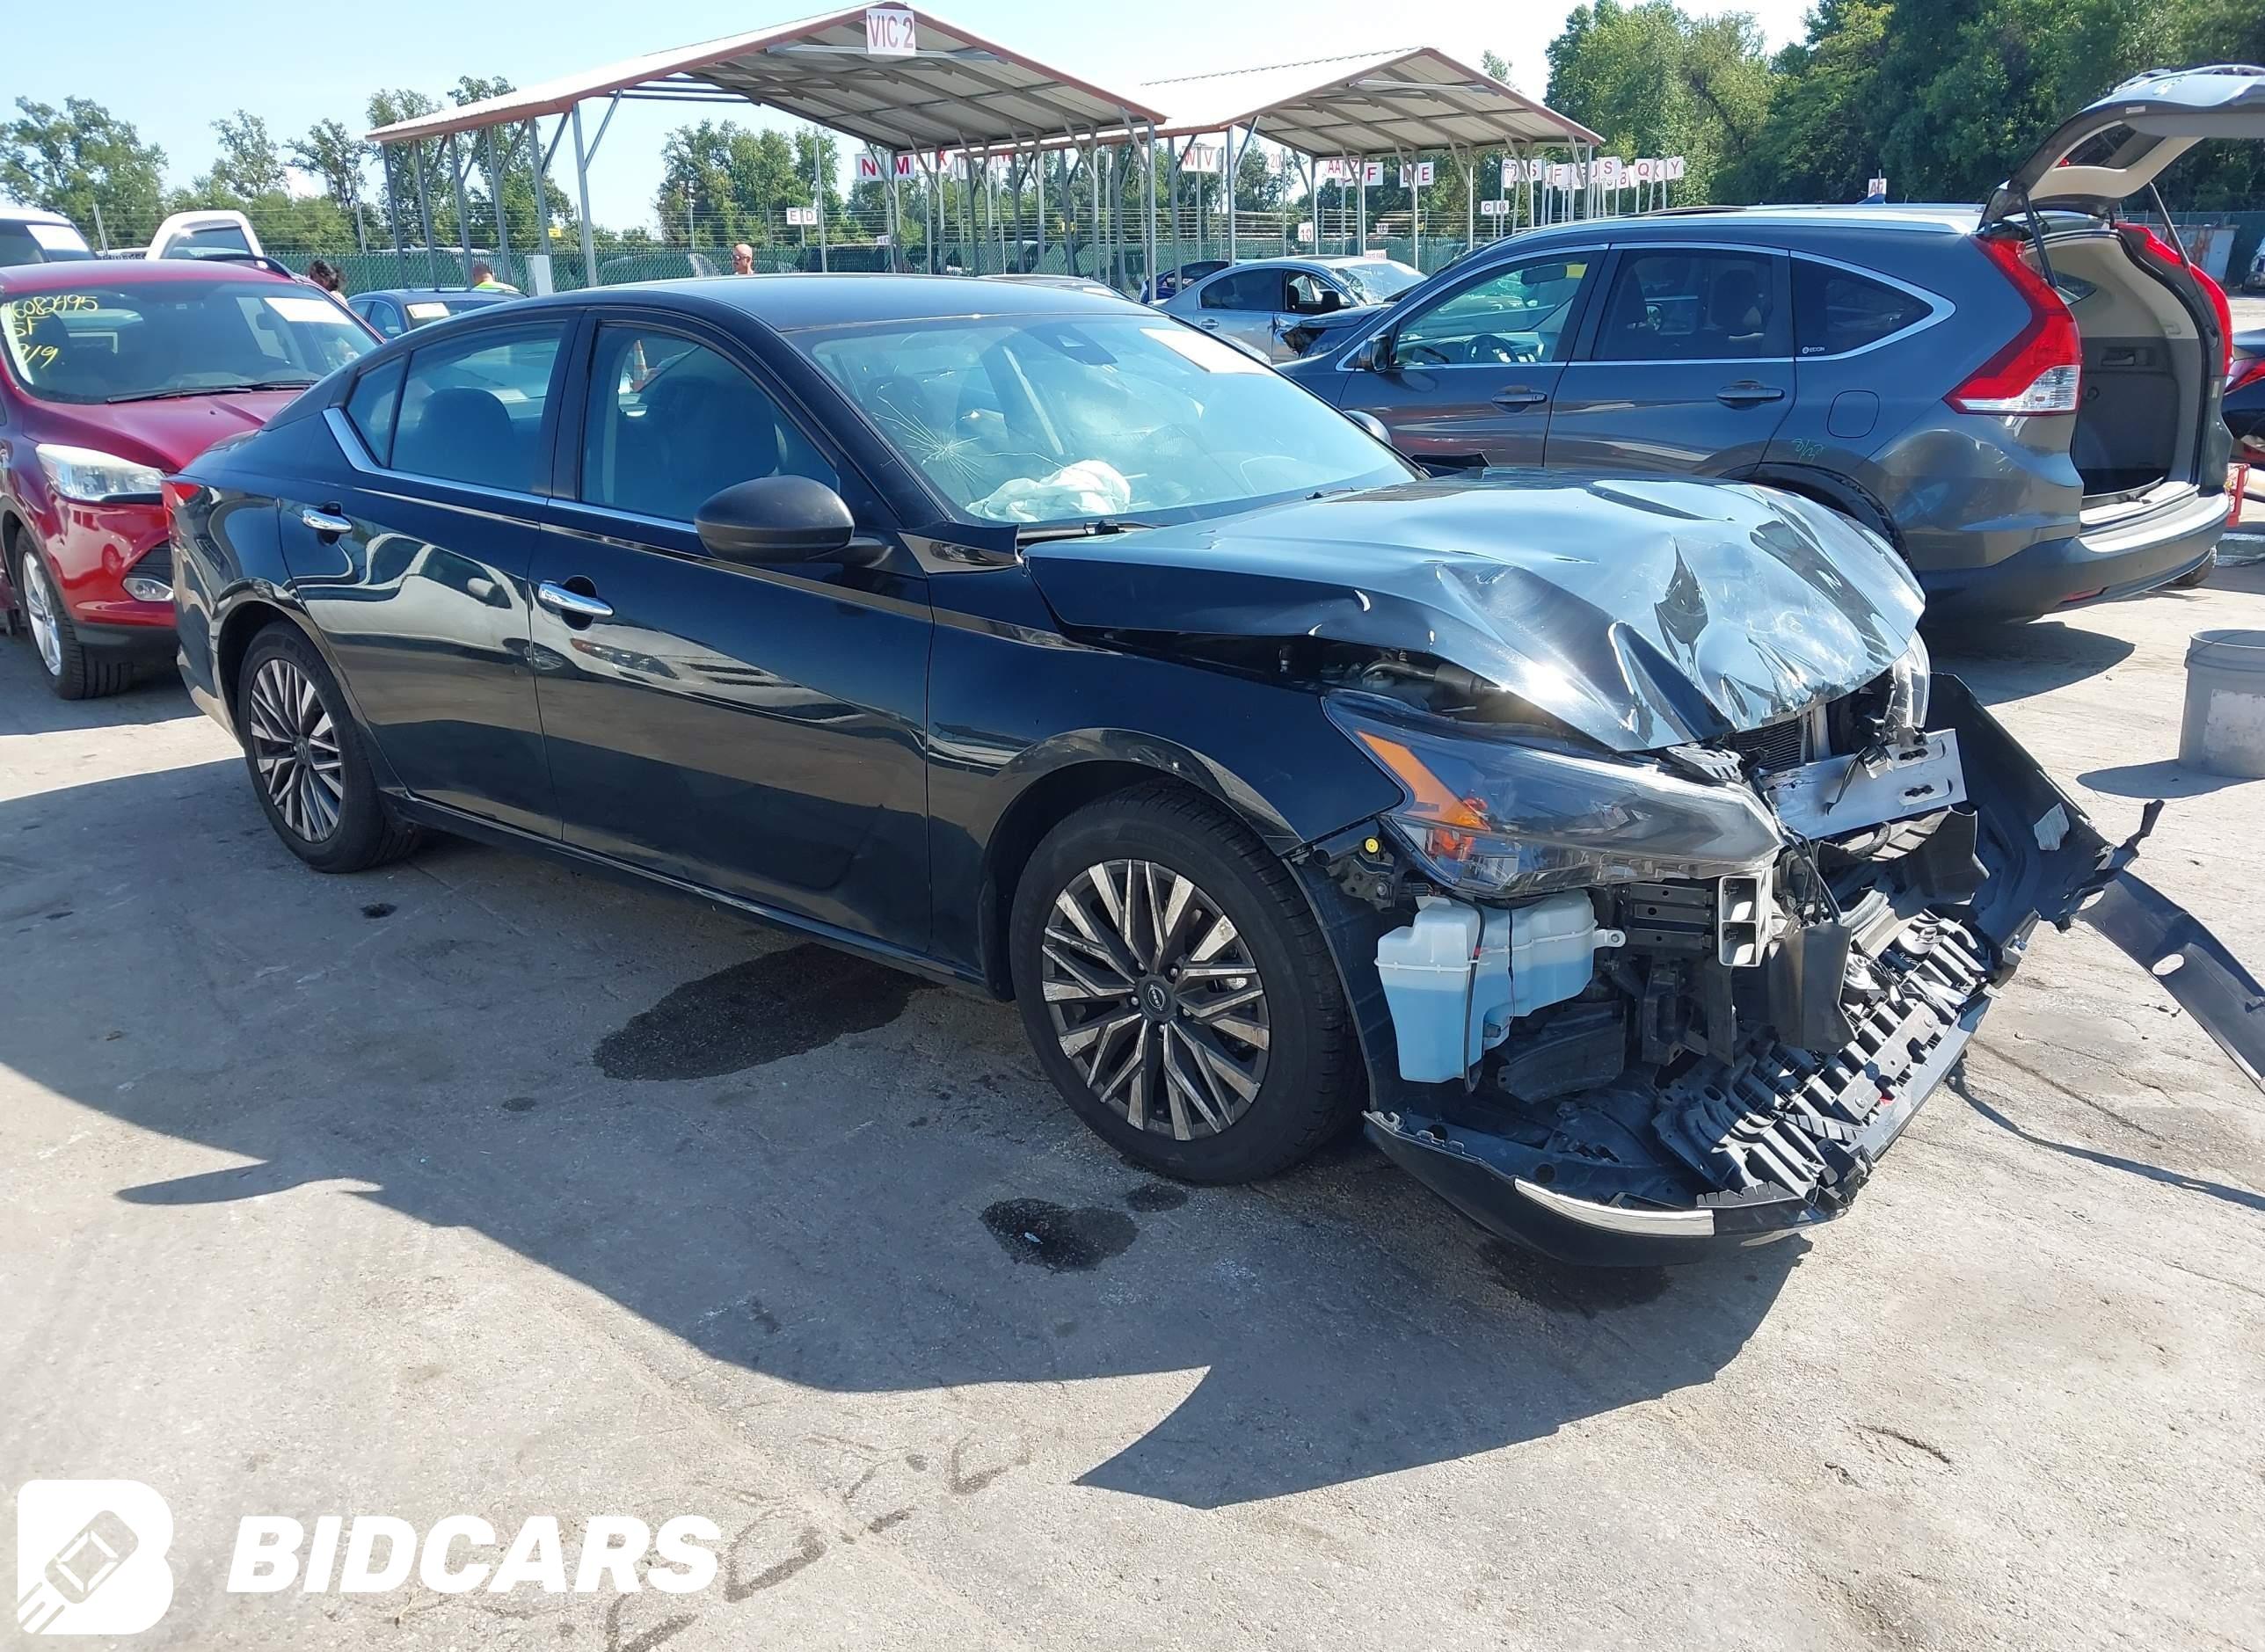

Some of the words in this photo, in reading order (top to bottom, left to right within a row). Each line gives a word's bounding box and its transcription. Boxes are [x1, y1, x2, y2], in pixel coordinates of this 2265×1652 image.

[868, 14, 898, 48] VIC
[902, 16, 914, 49] 2
[861, 157, 877, 177] N
[895, 155, 910, 175] M
[1205, 150, 1213, 167] V
[1328, 159, 1342, 174] AA
[1367, 166, 1378, 182] F
[1422, 167, 1430, 181] E
[1603, 160, 1613, 175] S
[1637, 162, 1650, 178] Q
[1671, 161, 1679, 175] Y
[1483, 203, 1491, 213] C
[790, 210, 797, 222] E
[805, 210, 813, 222] D
[1300, 228, 1313, 241] 10
